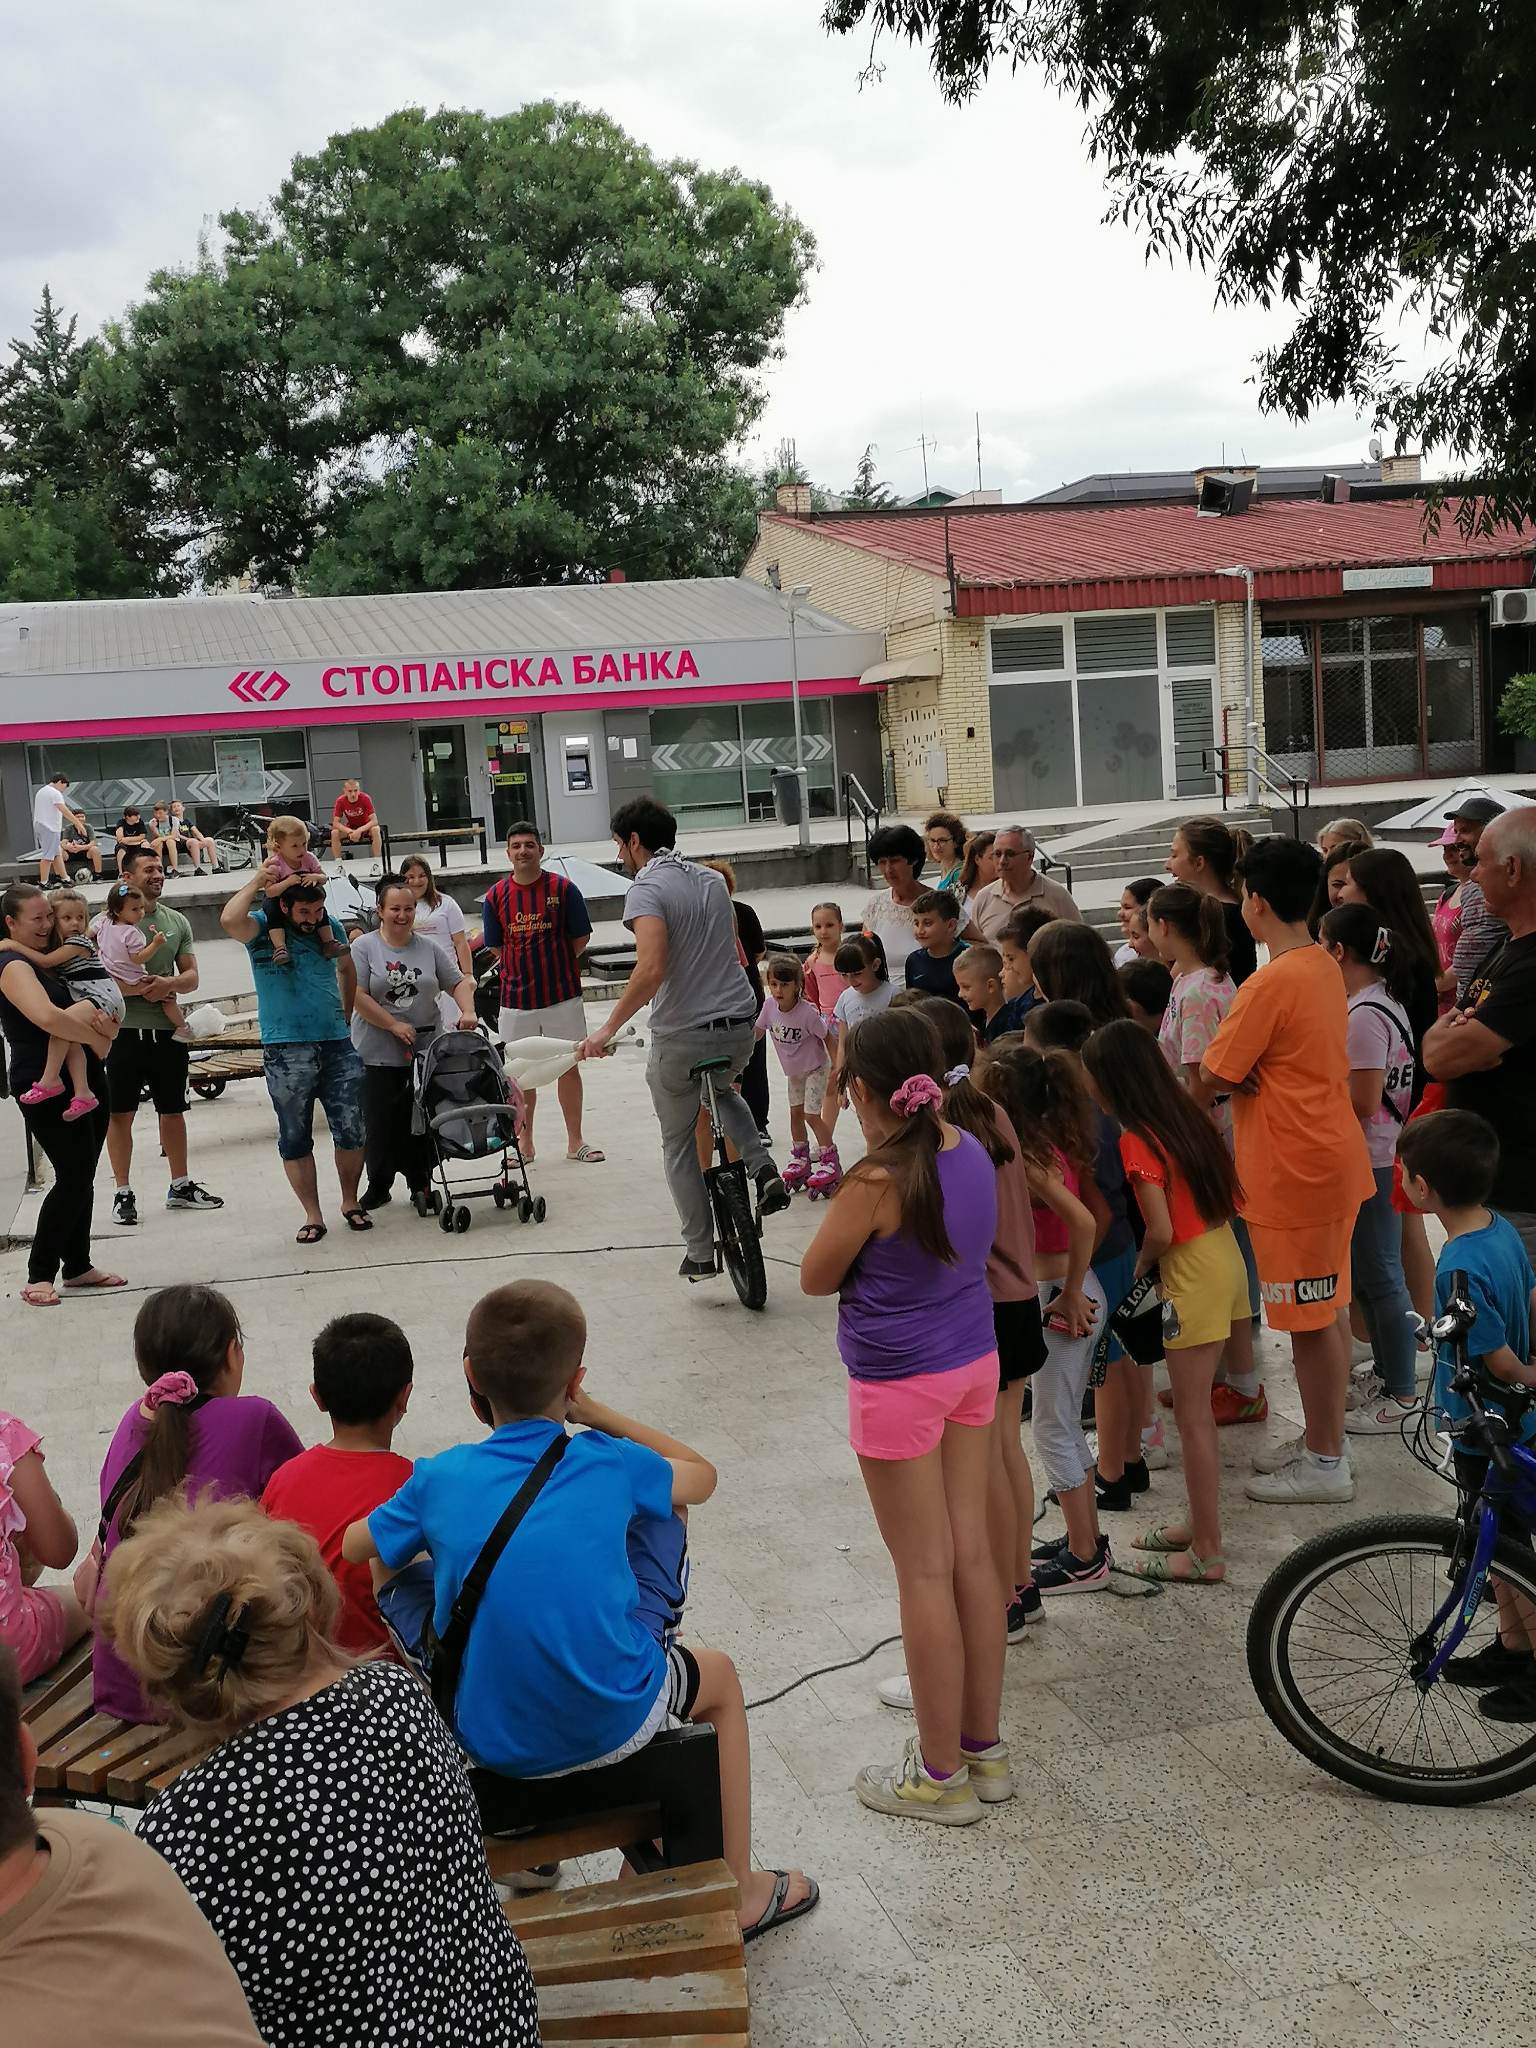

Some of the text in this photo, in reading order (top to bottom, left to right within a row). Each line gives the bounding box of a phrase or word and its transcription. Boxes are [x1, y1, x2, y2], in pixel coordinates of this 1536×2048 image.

[322, 650, 700, 697] СТОПАНСКА БАНКА
[1298, 1277, 1335, 1301] CHILL
